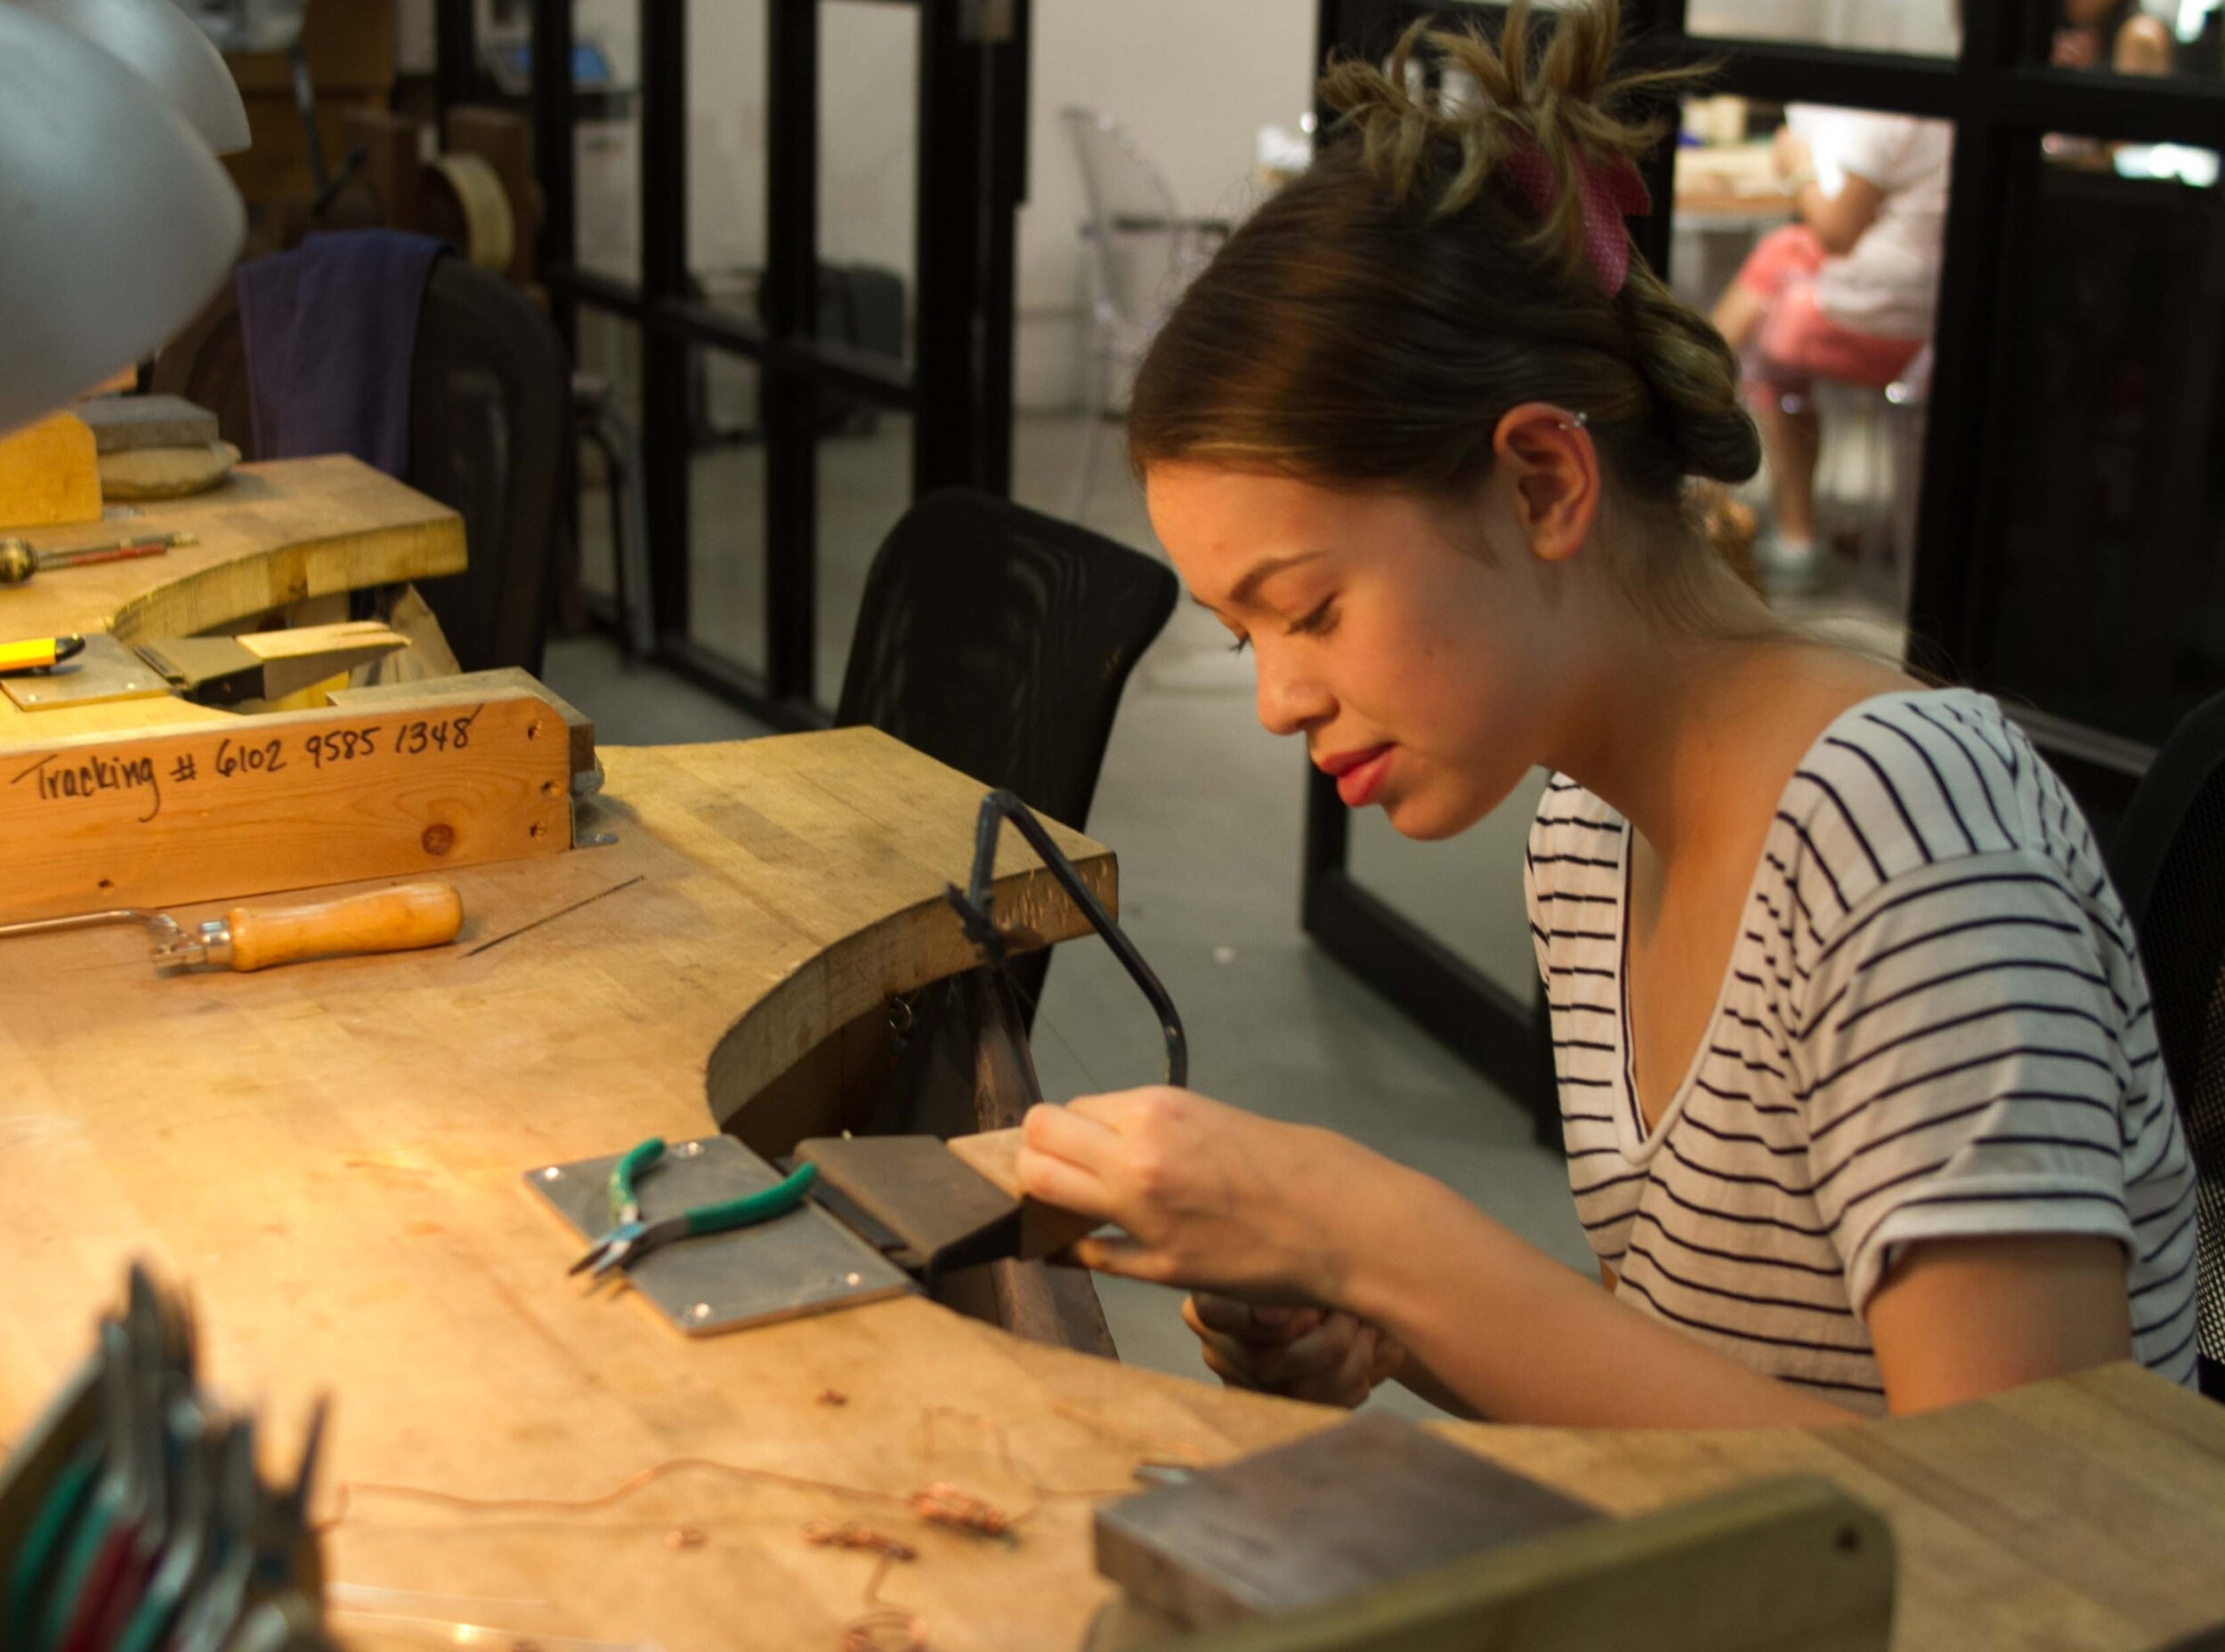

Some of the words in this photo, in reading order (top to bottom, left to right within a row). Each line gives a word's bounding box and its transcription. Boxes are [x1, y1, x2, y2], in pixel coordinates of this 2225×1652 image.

[11, 754, 160, 822] Tracking
[169, 754, 198, 782] #
[215, 740, 287, 777] 6102
[305, 727, 380, 768] 9585
[394, 704, 484, 754] 1348
